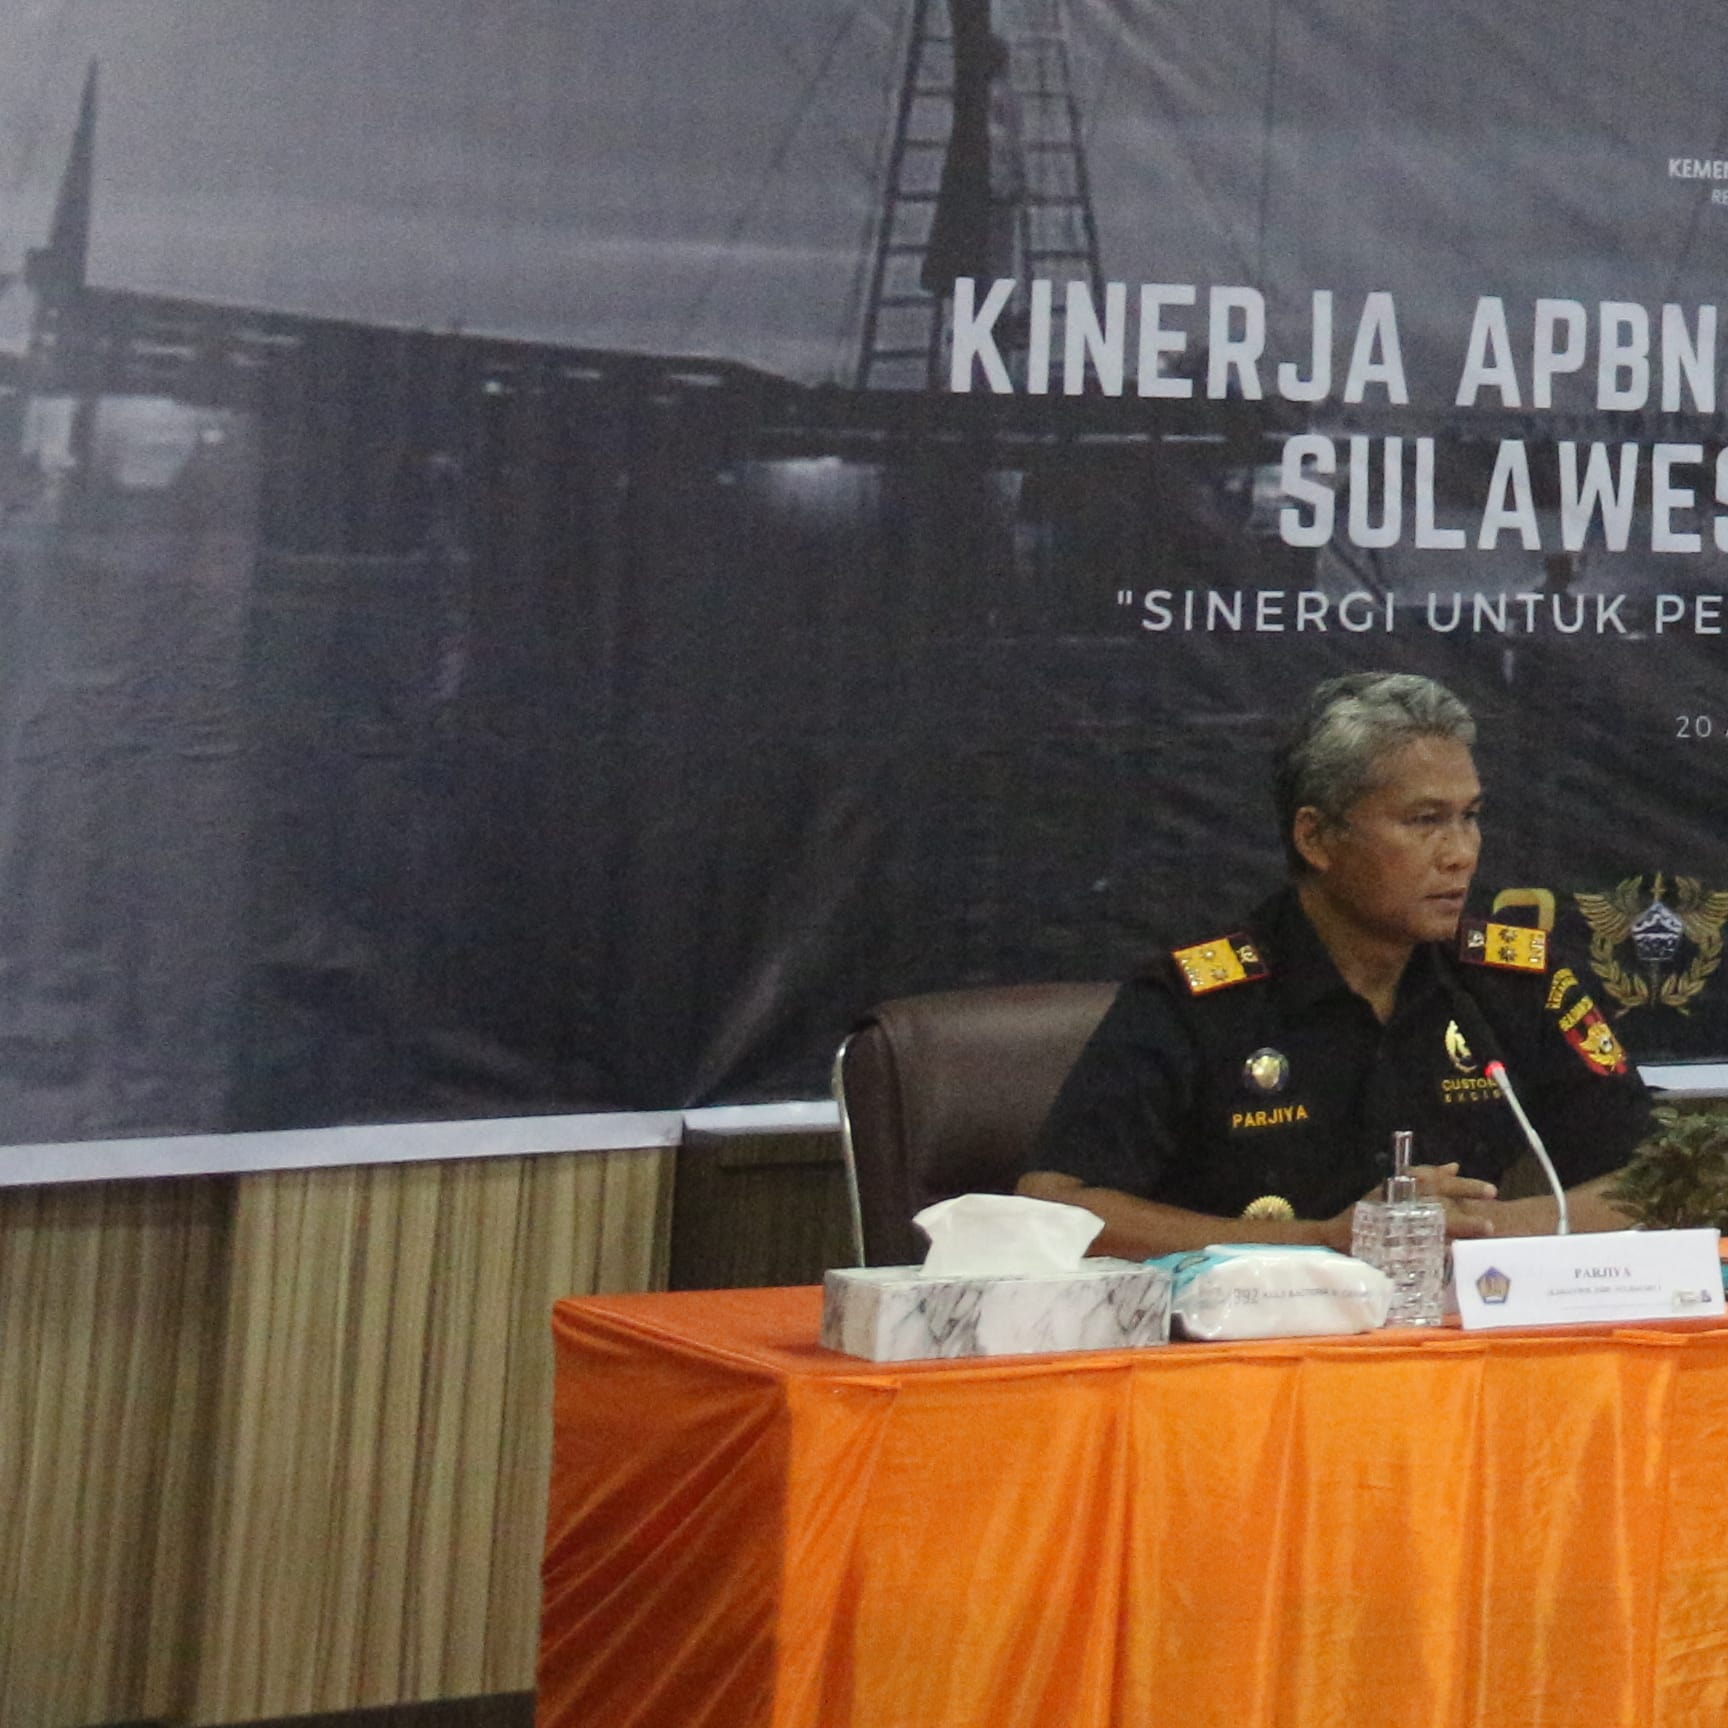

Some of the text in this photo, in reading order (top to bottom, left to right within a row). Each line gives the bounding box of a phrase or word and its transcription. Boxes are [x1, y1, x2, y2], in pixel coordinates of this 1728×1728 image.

[949, 277, 1409, 405] KINERJA
[1454, 295, 1718, 413] APBN
[1115, 588, 1396, 633] "SINERGI
[1426, 591, 1629, 634] UNTUK
[1674, 715, 1713, 739] 20
[1441, 1077, 1498, 1092] CUSTOM
[1443, 1088, 1502, 1103] EXCIS
[1231, 1103, 1309, 1129] PARJIYA
[1573, 1266, 1632, 1279] PARJIYA
